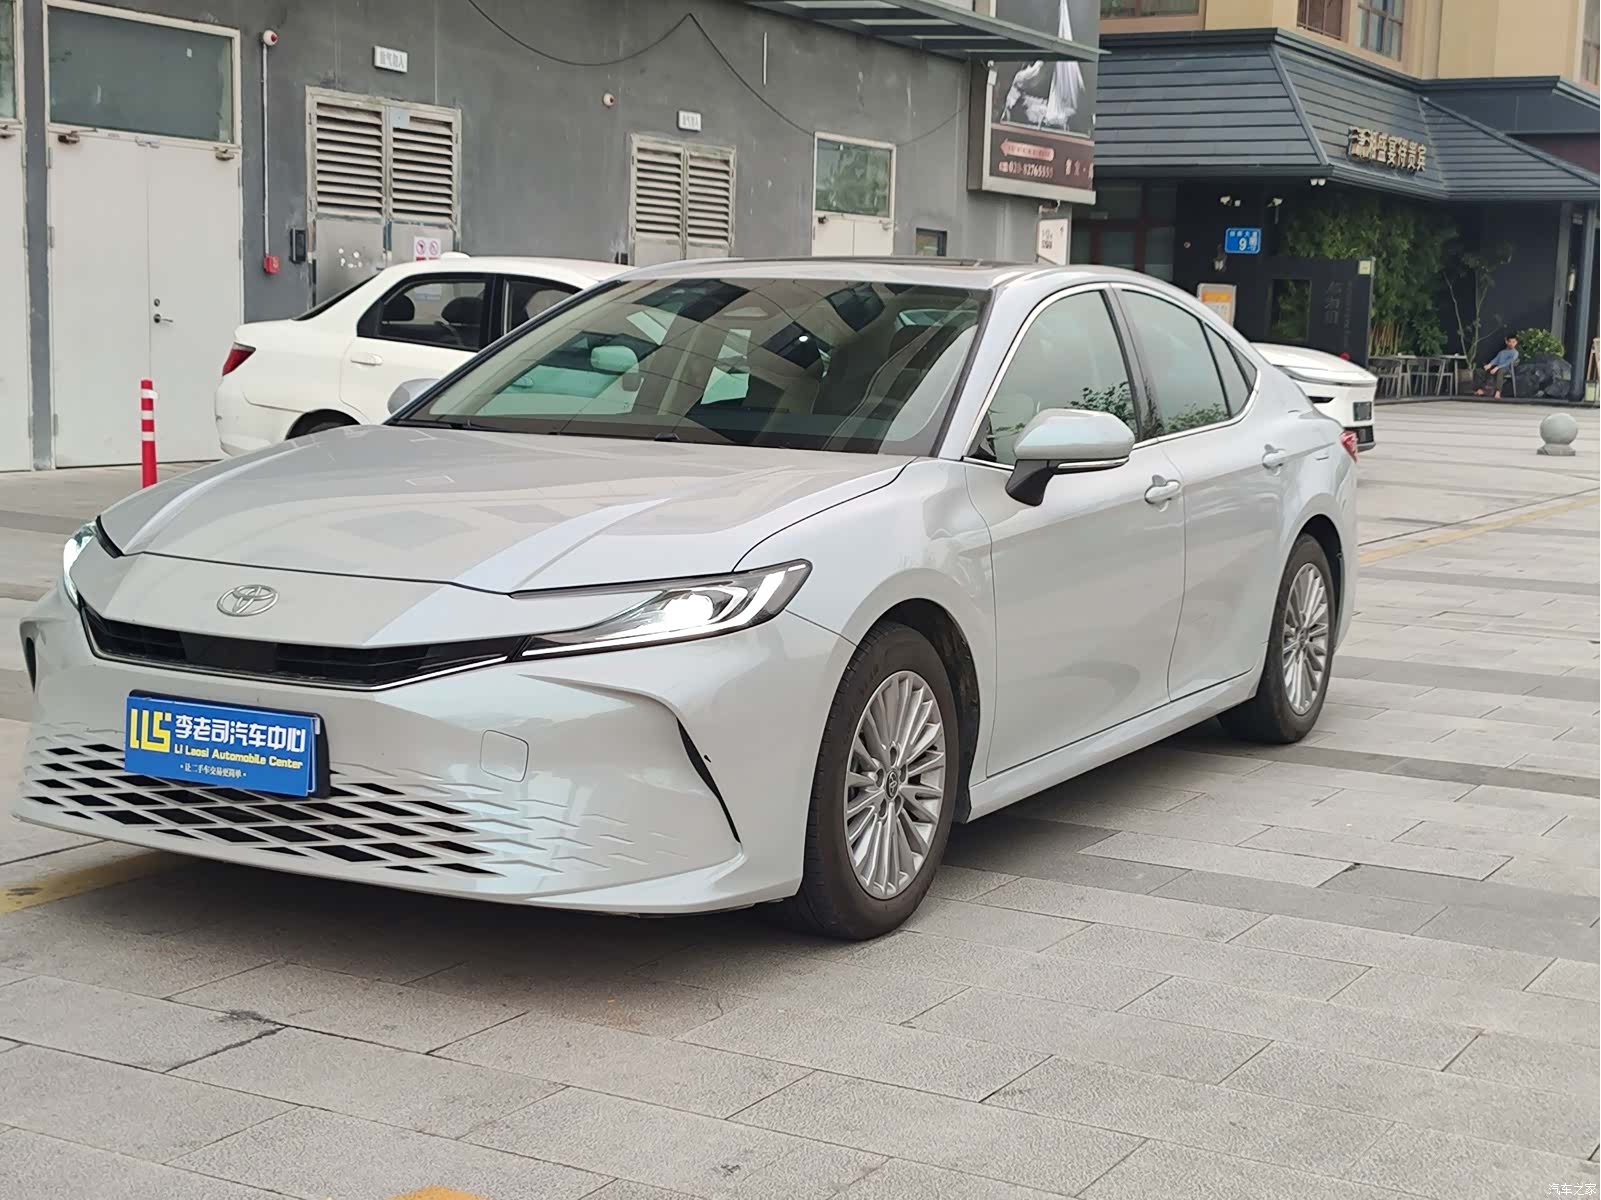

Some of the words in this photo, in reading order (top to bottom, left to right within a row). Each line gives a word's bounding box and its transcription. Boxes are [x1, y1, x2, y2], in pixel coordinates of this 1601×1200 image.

[175, 714, 306, 753] 李老司汽车中心
[174, 743, 184, 754] Li
[211, 747, 267, 765] Automobile
[268, 755, 304, 770] Center
